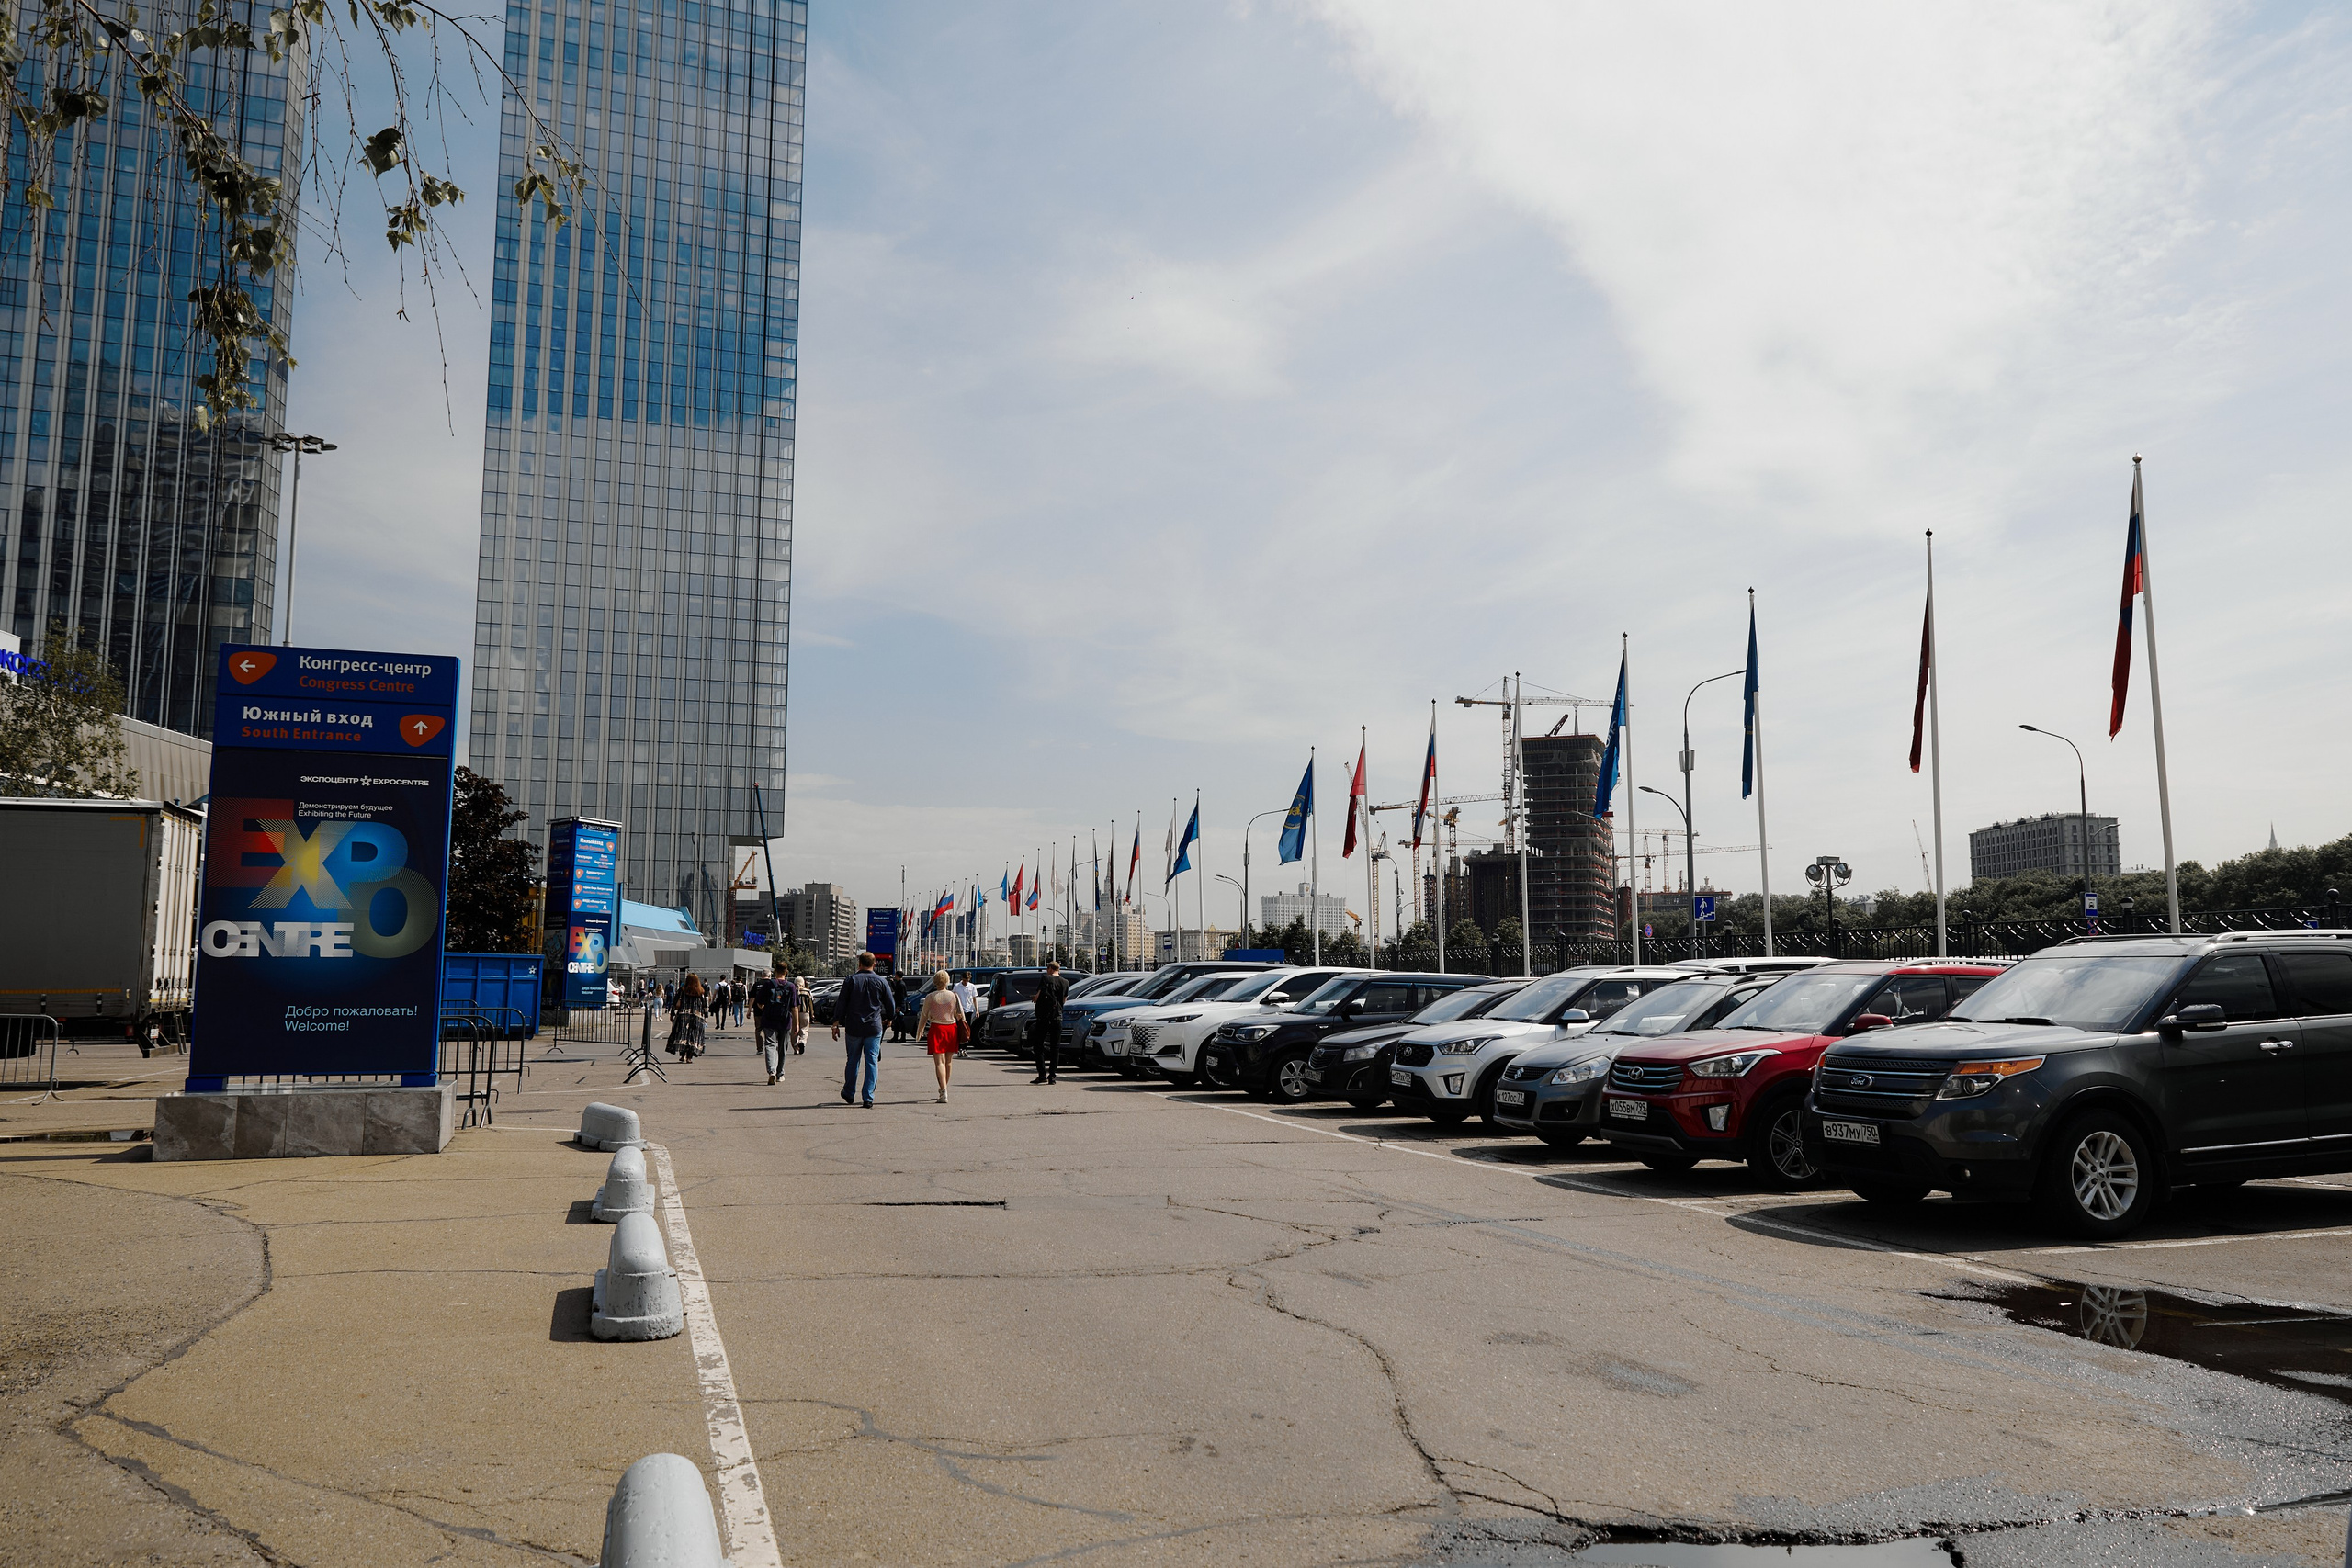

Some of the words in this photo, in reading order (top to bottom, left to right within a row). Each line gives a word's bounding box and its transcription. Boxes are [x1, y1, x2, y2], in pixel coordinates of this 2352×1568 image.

[300, 655, 432, 678] Конгресс-центр
[299, 675, 366, 692] Congress
[369, 679, 415, 693] Centre
[242, 706, 322, 723] Южный
[326, 712, 373, 728] вход
[241, 726, 288, 739] South
[292, 728, 362, 742] Entrance
[300, 775, 359, 784] ЭКСПОЦЕНТР
[372, 778, 430, 786] EXPOCENTRE
[298, 801, 359, 811] Демонстрируем
[360, 804, 393, 812] будущее
[298, 809, 334, 818] Exhibiting
[206, 796, 439, 958] EXPO
[285, 1005, 329, 1019] Добро
[333, 1005, 418, 1017] пожаловать!
[284, 1020, 350, 1032] Welcome!
